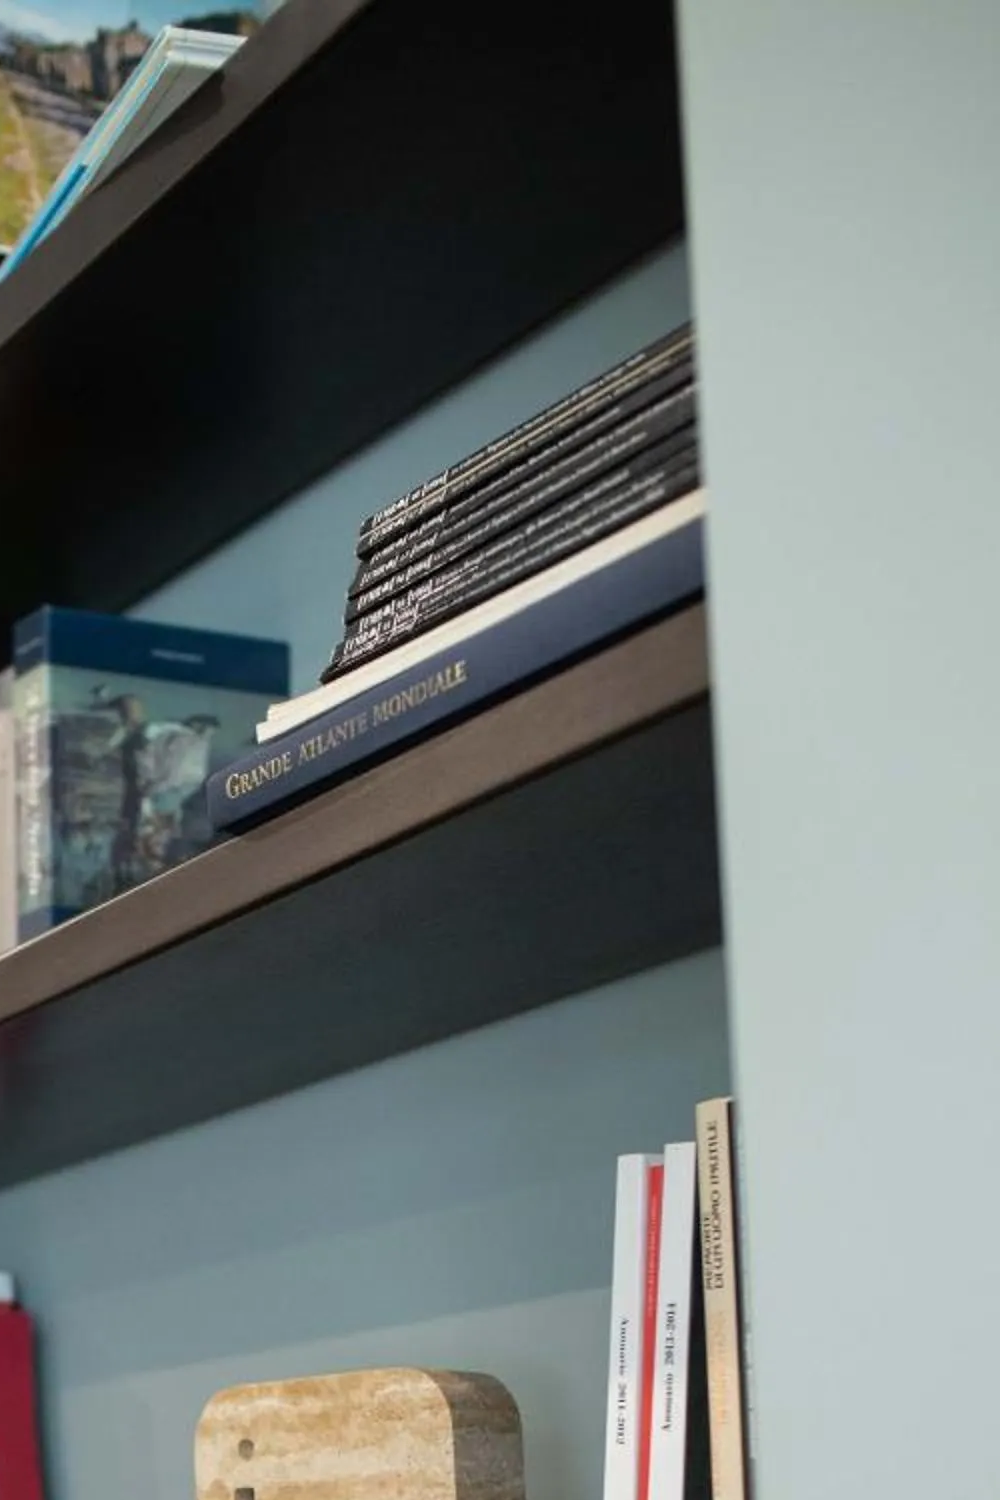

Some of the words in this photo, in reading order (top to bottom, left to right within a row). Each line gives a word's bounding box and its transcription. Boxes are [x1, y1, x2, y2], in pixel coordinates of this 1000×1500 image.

[225, 742, 294, 799] GRANDE
[298, 711, 369, 764] ATLANTE
[372, 659, 468, 728] MONDIALE
[618, 1317, 630, 1377] Annuario
[661, 1372, 674, 1432] Annuario
